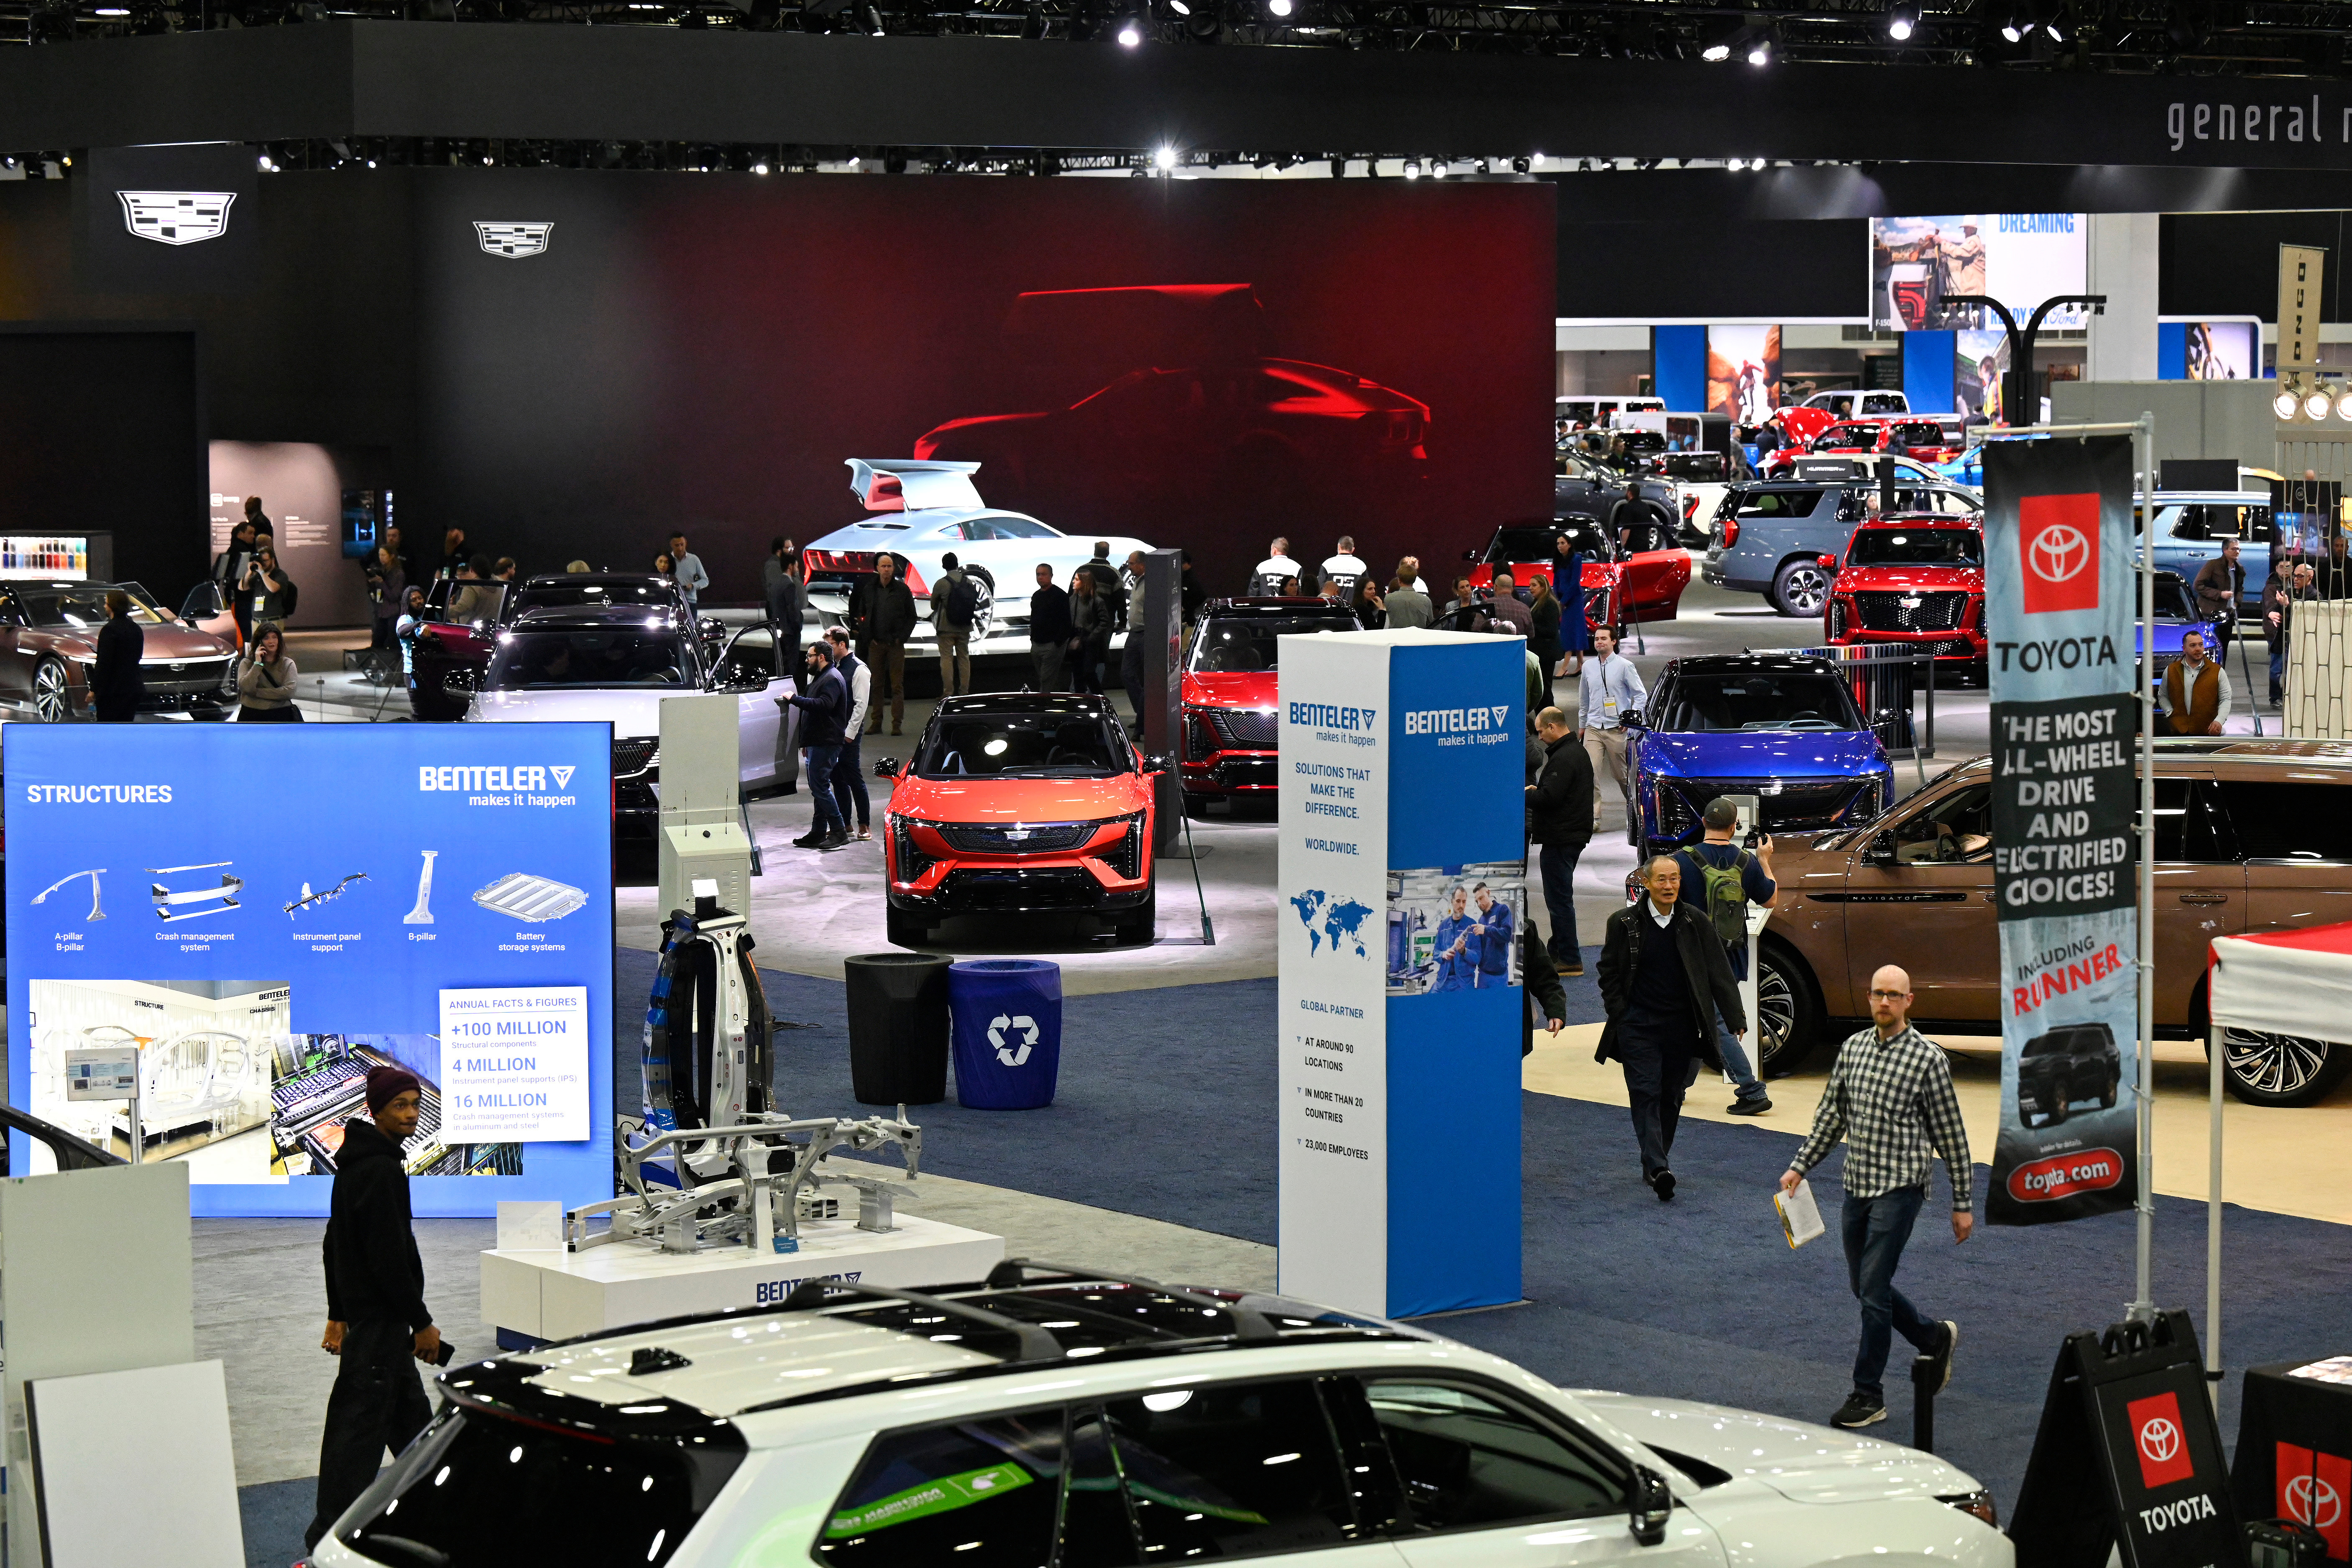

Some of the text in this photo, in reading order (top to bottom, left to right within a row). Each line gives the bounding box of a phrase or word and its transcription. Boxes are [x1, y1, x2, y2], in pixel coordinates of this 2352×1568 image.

[2168, 94, 2321, 151] general
[1999, 214, 2074, 233] DREAMING
[1995, 636, 2117, 672] TOYOTA
[1290, 702, 1359, 730] BENTELER
[1405, 707, 1489, 735] BENTELER
[2055, 709, 2117, 741] MOST
[1316, 731, 1375, 747] makes it happen
[1438, 733, 1508, 747] makes it happen
[419, 766, 546, 791] BENTELER
[1296, 763, 1370, 781] SOLUTIONS THAT
[28, 785, 172, 803] STRUCTURES
[1311, 783, 1355, 799] MAKE THE
[2018, 776, 2095, 806] DRIVE
[469, 794, 575, 808] makes it happen
[1305, 802, 1359, 819] DIFFERENCE.
[2027, 810, 2089, 838] AND
[1305, 838, 1359, 855] WORLDWIDE.
[55, 932, 83, 942] A-pillar
[181, 933, 234, 942] management
[339, 933, 361, 942] panel
[409, 933, 436, 942] B-pillar
[516, 933, 545, 942] Battery
[56, 943, 84, 953] B-pillar
[181, 944, 210, 953] system
[312, 944, 343, 953] support
[498, 944, 565, 953] storage systems
[135, 1000, 164, 1010] STRUCTURE
[450, 1000, 489, 1009] ANNUAL
[1301, 1000, 1364, 1019] GLOBAL PARTNER
[452, 1021, 565, 1036] +100 MILLION
[1305, 1037, 1354, 1053] AT AROUND 90
[453, 1057, 535, 1072] 4 MILLION
[1305, 1056, 1343, 1071] LOCATIONS
[454, 1093, 547, 1108] 16 MILLION
[1305, 1088, 1363, 1107] IN MORE THAN 20
[1305, 1108, 1343, 1123] COUNTRIES
[1305, 1139, 1368, 1159] 23,000 EMPLOYEES
[2140, 1494, 2217, 1534] TOYOTA
